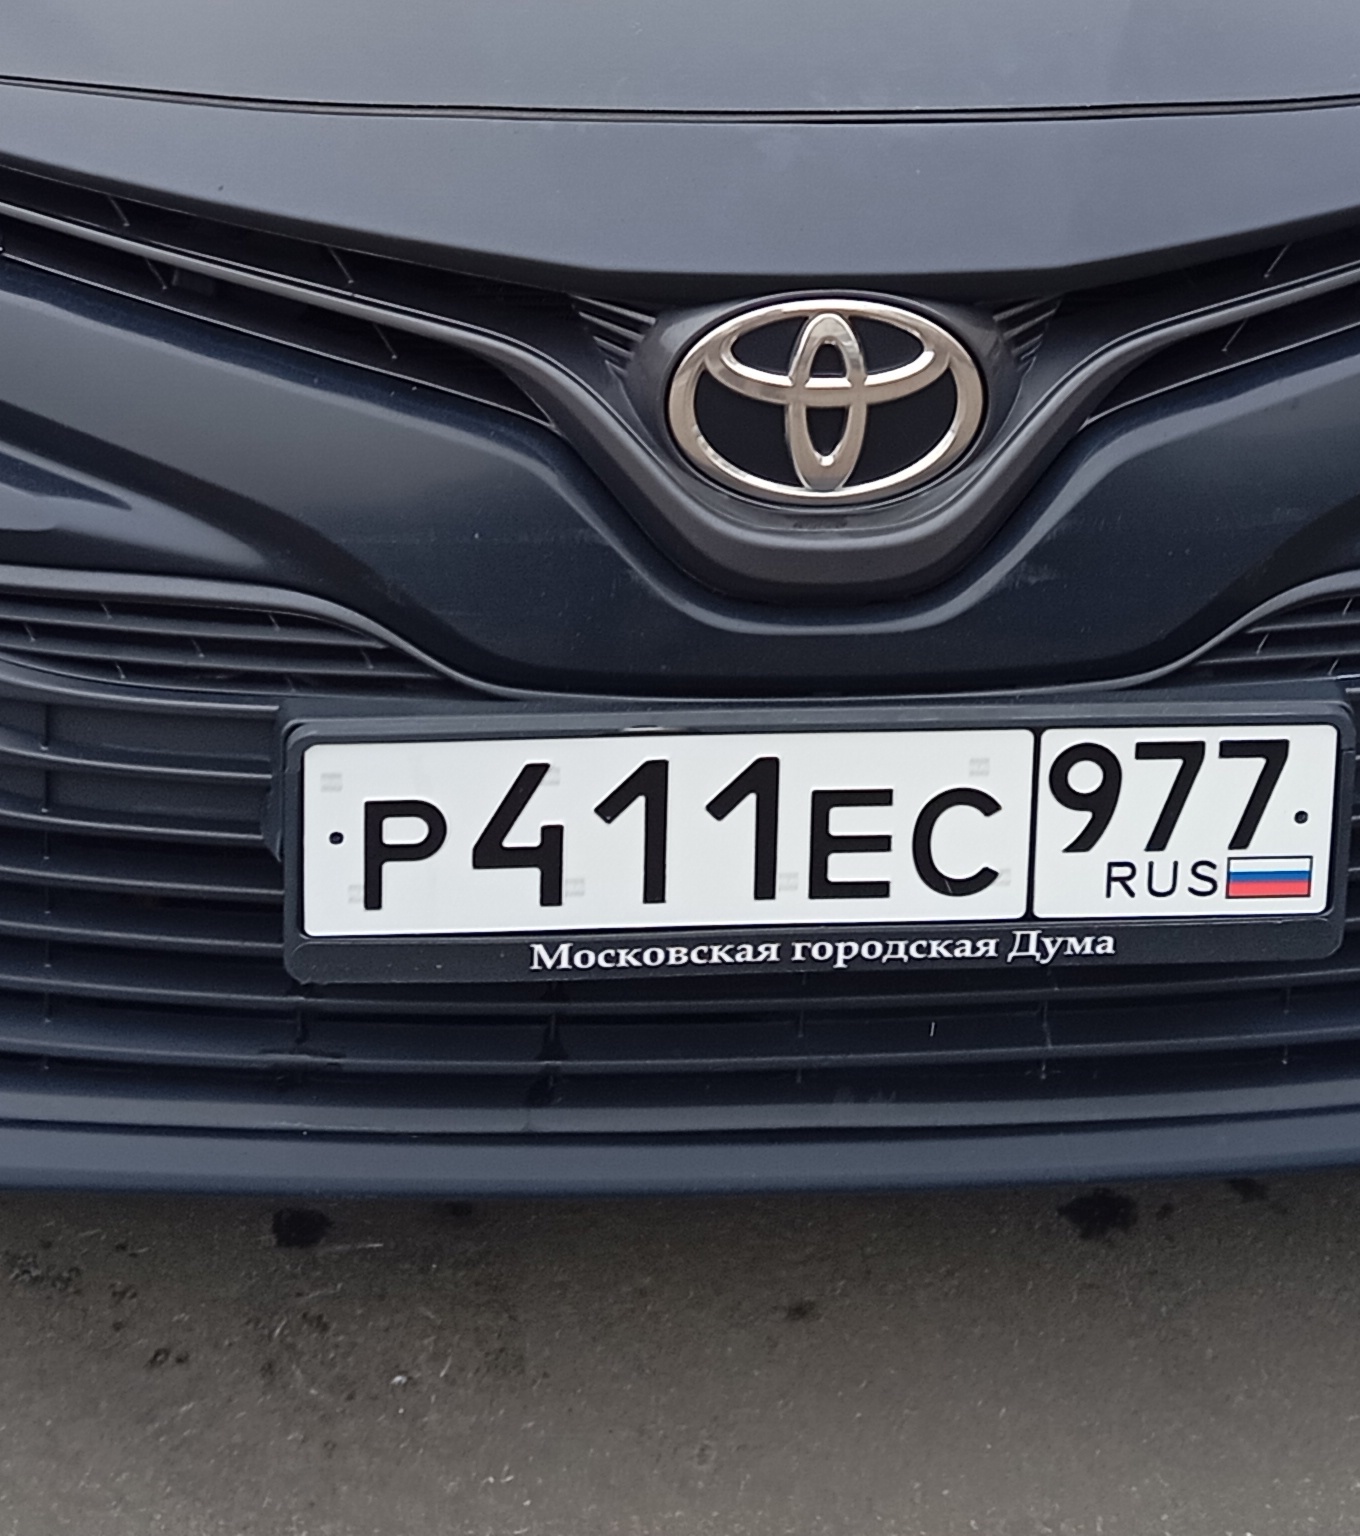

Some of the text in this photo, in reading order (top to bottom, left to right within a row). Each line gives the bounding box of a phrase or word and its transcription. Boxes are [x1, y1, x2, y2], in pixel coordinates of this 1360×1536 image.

[363, 738, 1290, 912] Р411ЕС 977
[1105, 859, 1219, 899] RUS
[528, 931, 1117, 971] Московская городская Дума
